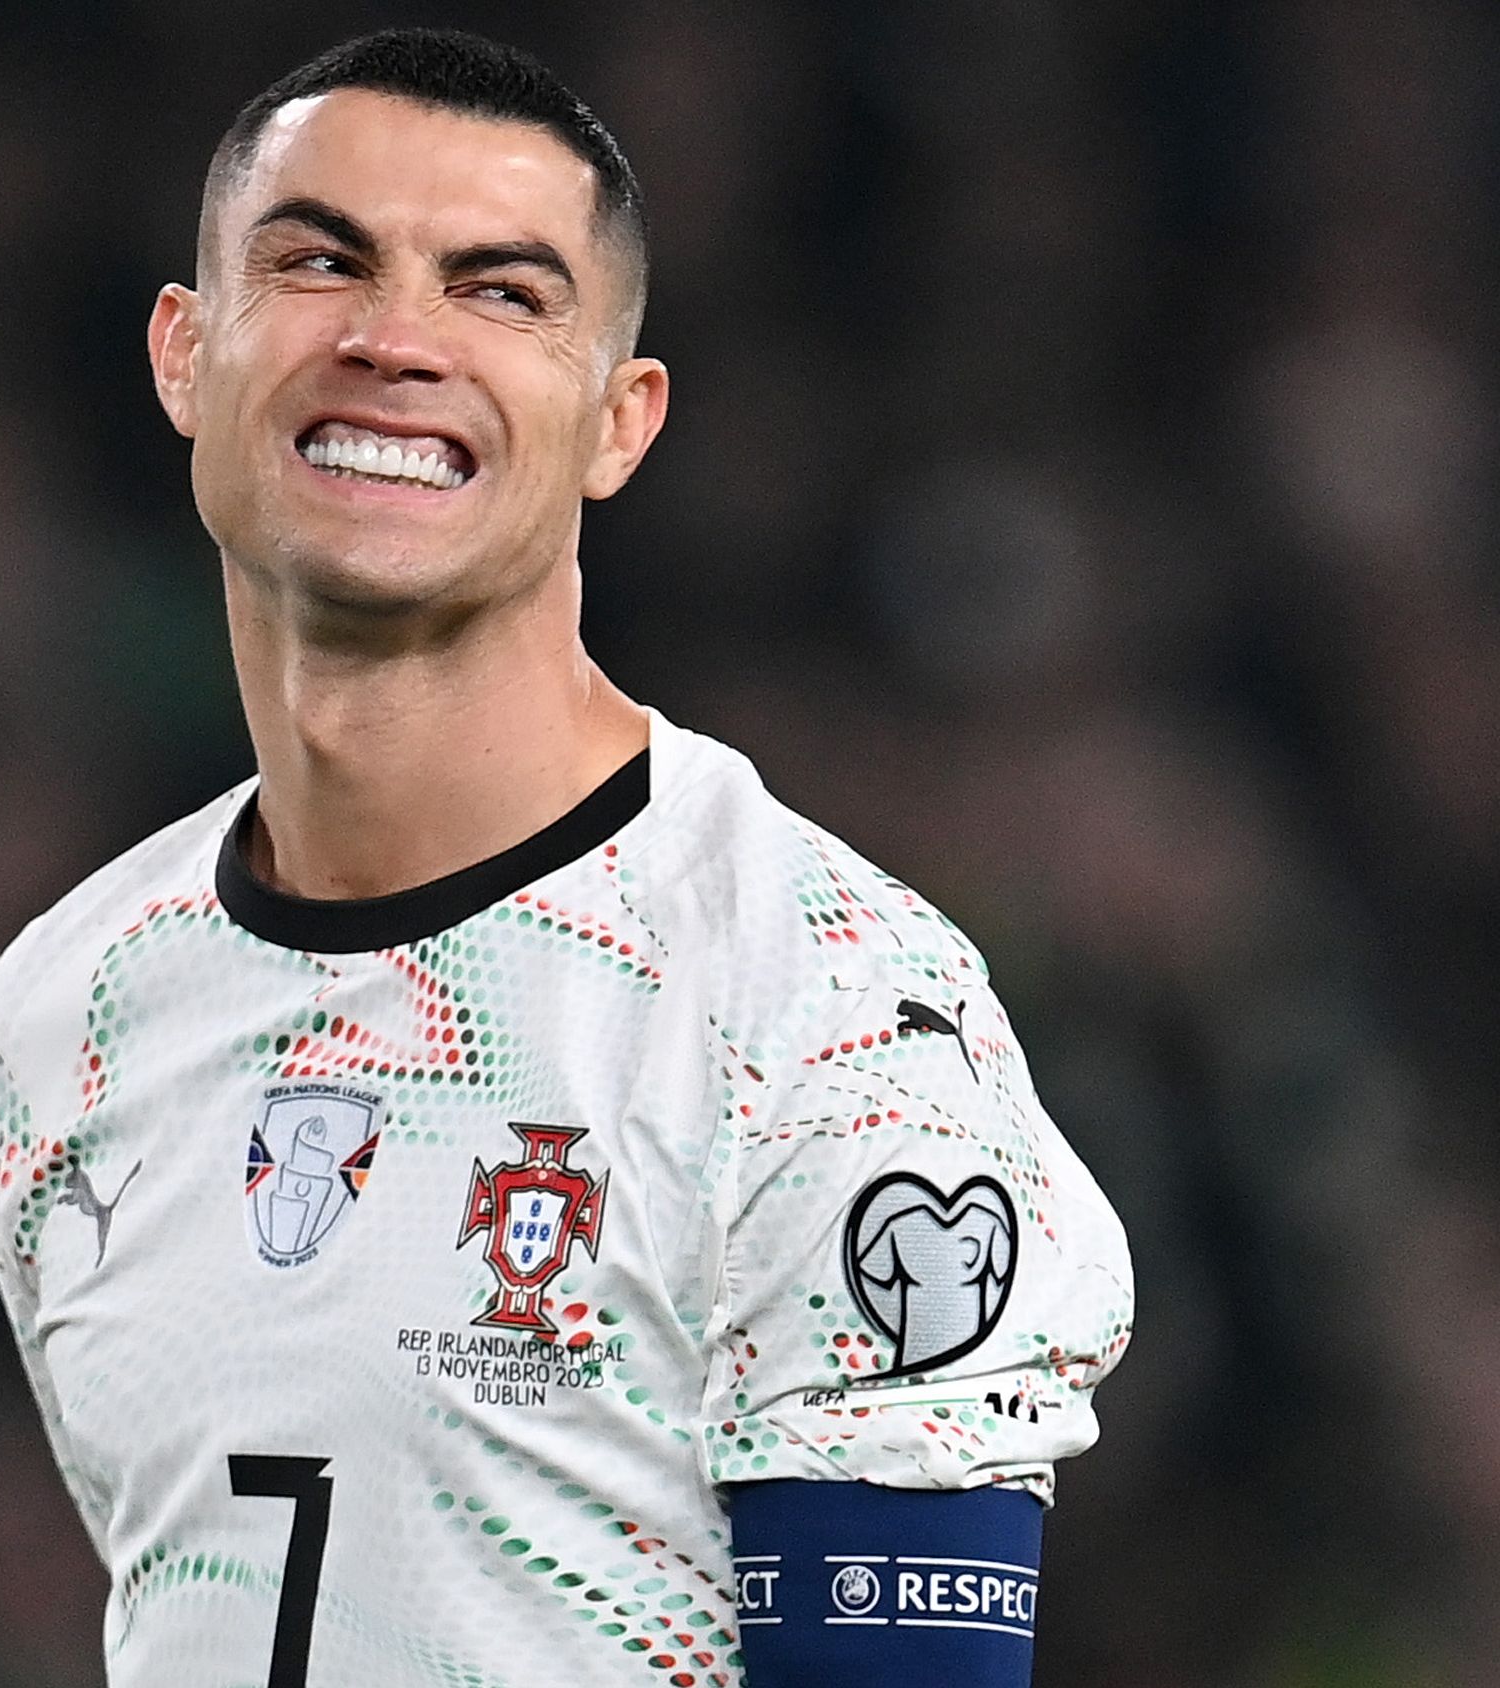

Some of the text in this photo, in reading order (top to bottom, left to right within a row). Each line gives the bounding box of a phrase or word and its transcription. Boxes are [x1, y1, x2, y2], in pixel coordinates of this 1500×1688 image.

[264, 1087, 290, 1099] UEFA
[343, 1087, 383, 1105] LEAGUE
[398, 1329, 626, 1364] REP. IRLANDA/PORTUGAL
[416, 1355, 605, 1388] 13 NOVEMBRO 2025
[474, 1383, 546, 1407] DUBLIN
[802, 1390, 846, 1407] UEFA
[228, 1454, 334, 1688] 7
[898, 1571, 1038, 1622] RESPECT
